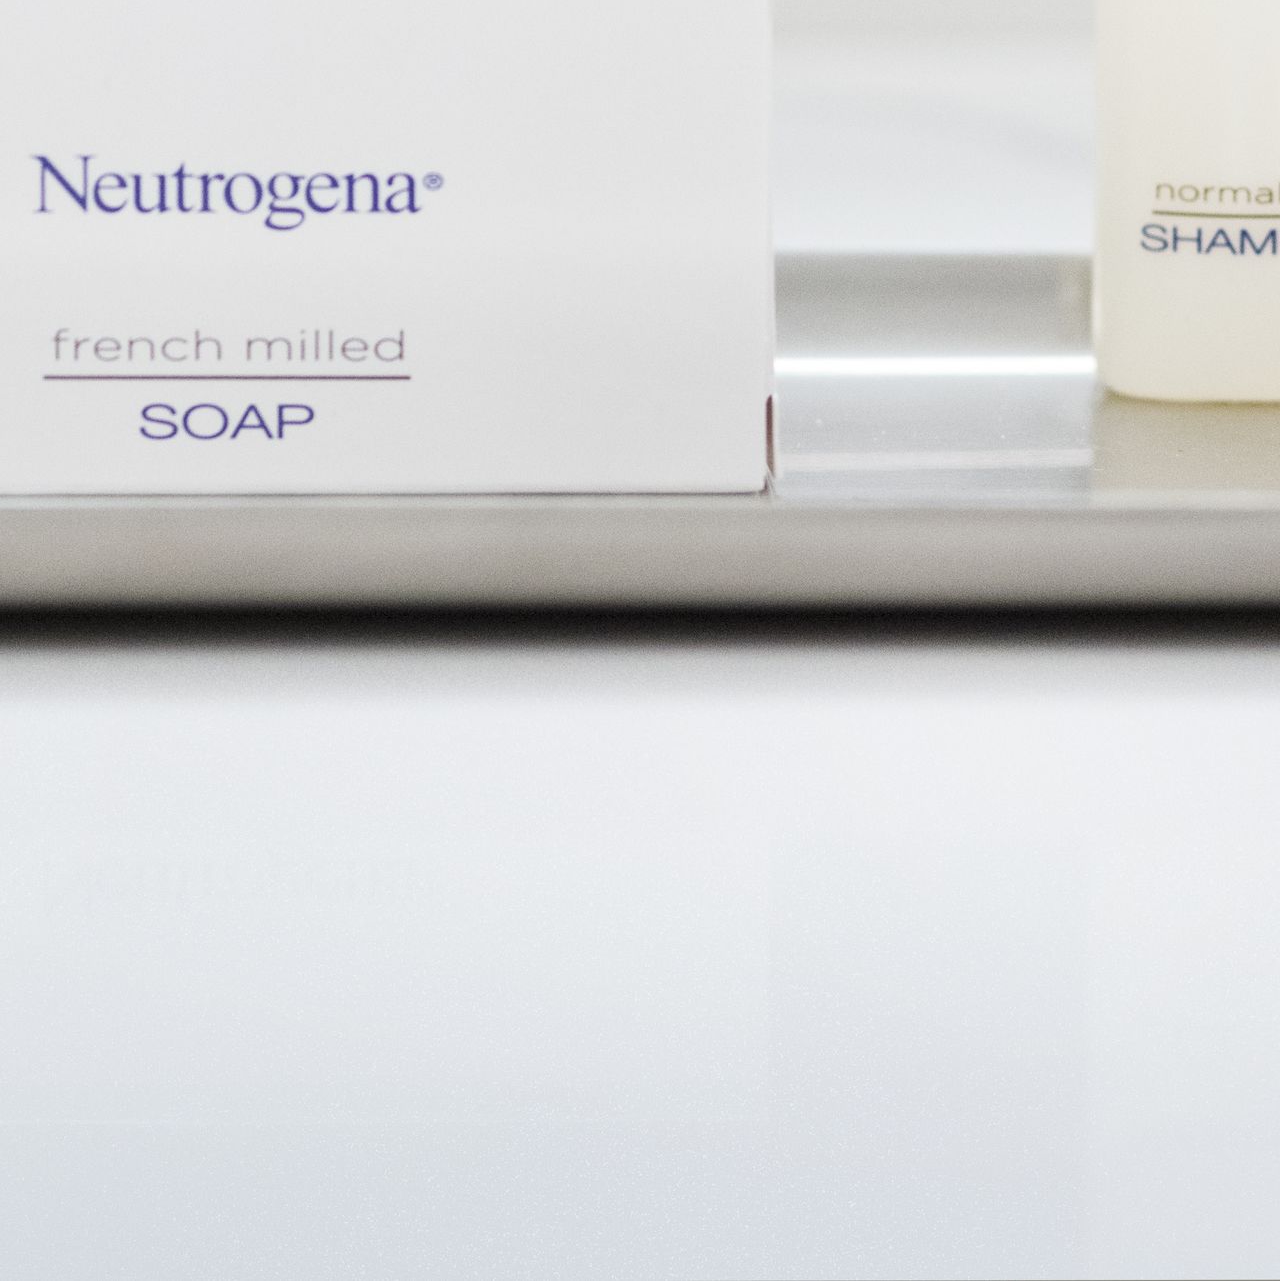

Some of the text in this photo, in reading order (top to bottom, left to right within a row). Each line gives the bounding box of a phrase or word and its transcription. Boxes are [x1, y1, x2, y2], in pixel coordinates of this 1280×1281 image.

[52, 327, 407, 363] french milled
[138, 402, 316, 441] SOAP
